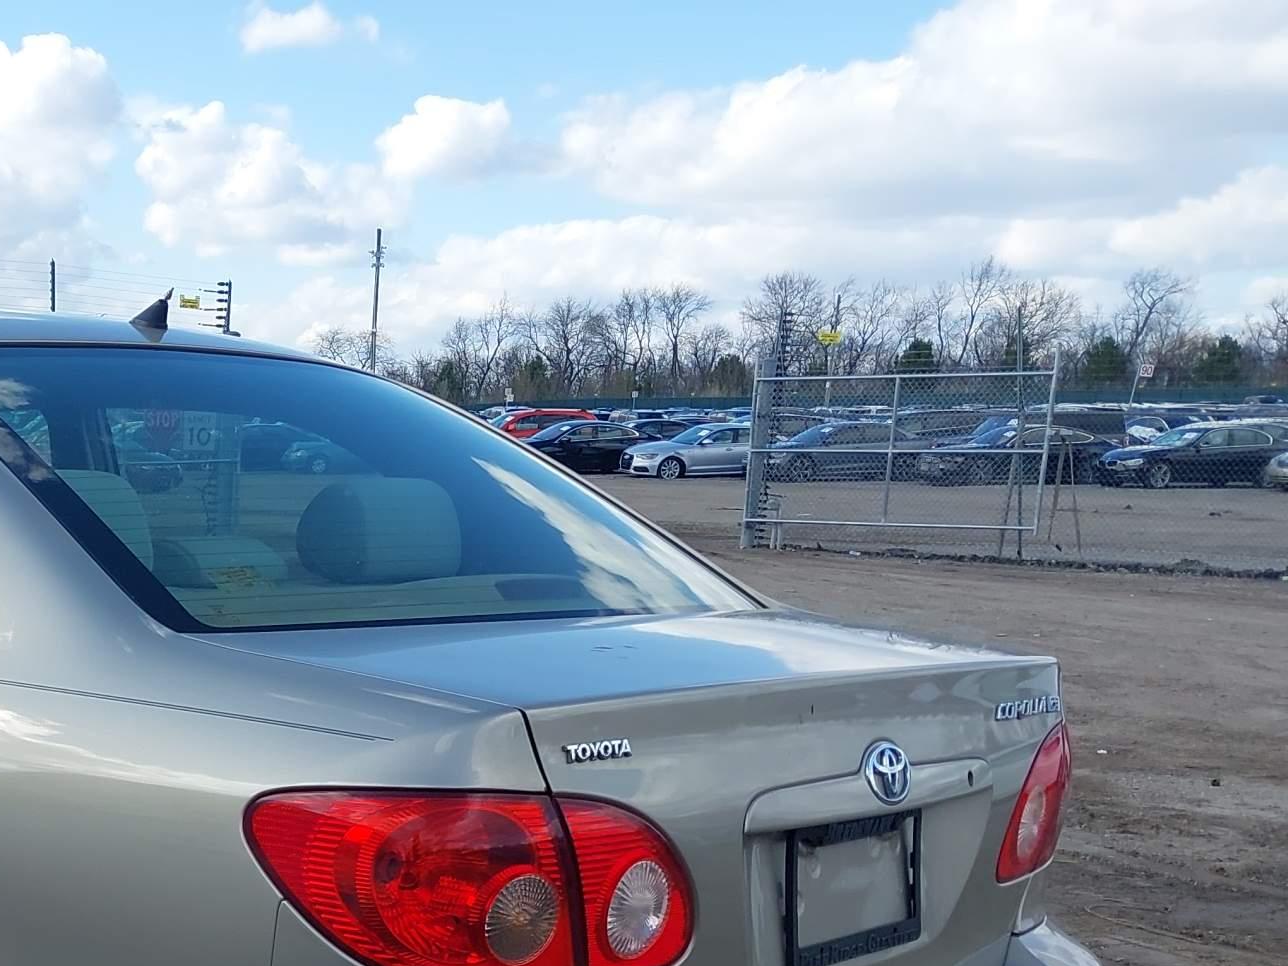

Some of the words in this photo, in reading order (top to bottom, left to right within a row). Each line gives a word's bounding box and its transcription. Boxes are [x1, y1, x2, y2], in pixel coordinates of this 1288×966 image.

[1141, 365, 1153, 375] 90
[145, 411, 179, 428] STOP
[189, 426, 211, 446] 10
[563, 738, 632, 763] TOYOTA
